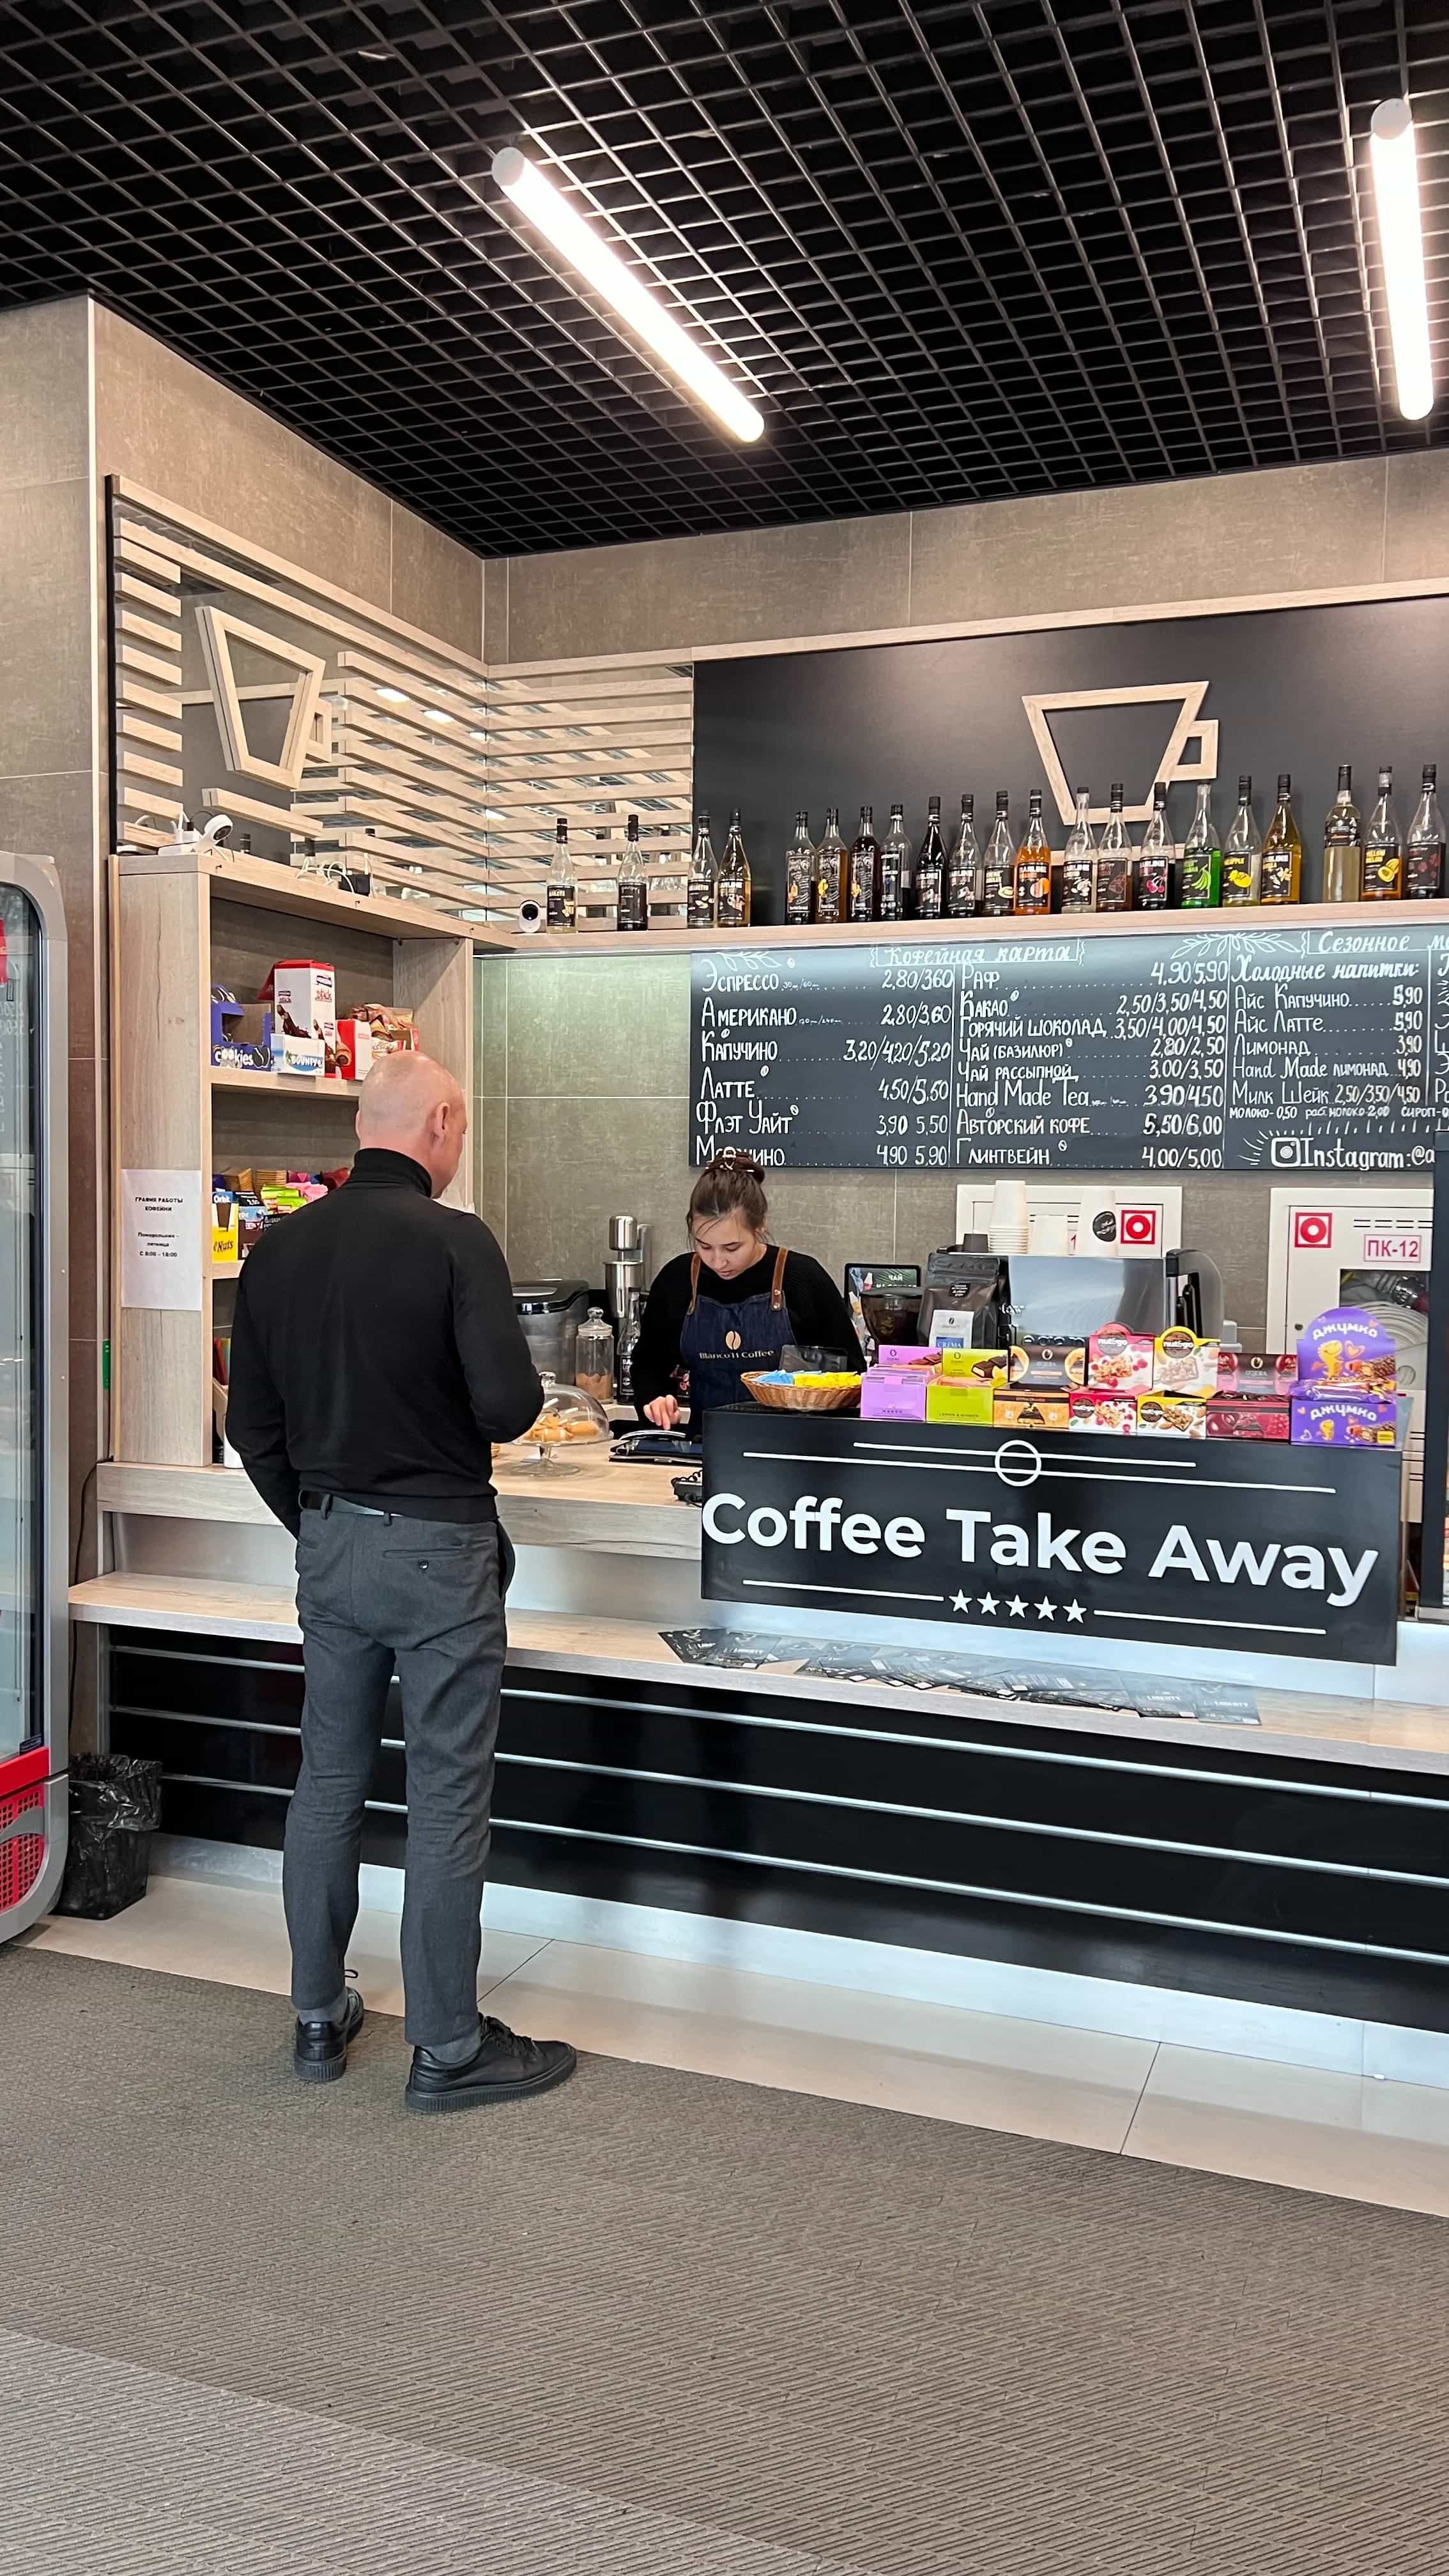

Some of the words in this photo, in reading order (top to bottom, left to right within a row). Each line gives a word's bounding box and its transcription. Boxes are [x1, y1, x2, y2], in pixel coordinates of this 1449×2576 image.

[1318, 931, 1411, 953] Сезонное
[887, 946, 985, 966] Кофейная
[995, 944, 1072, 962] карта
[1231, 954, 1326, 983] Холодные
[1232, 1057, 1276, 1078] Hand
[1280, 1056, 1328, 1080] Made
[956, 1081, 999, 1108] Hand
[1004, 1079, 1052, 1107] Made
[1052, 1075, 1090, 1107] Tea
[1367, 1239, 1419, 1258] ПК-12
[702, 1492, 926, 1560] Coffee
[945, 1506, 1127, 1575] Take
[1147, 1523, 1380, 1608] Away
